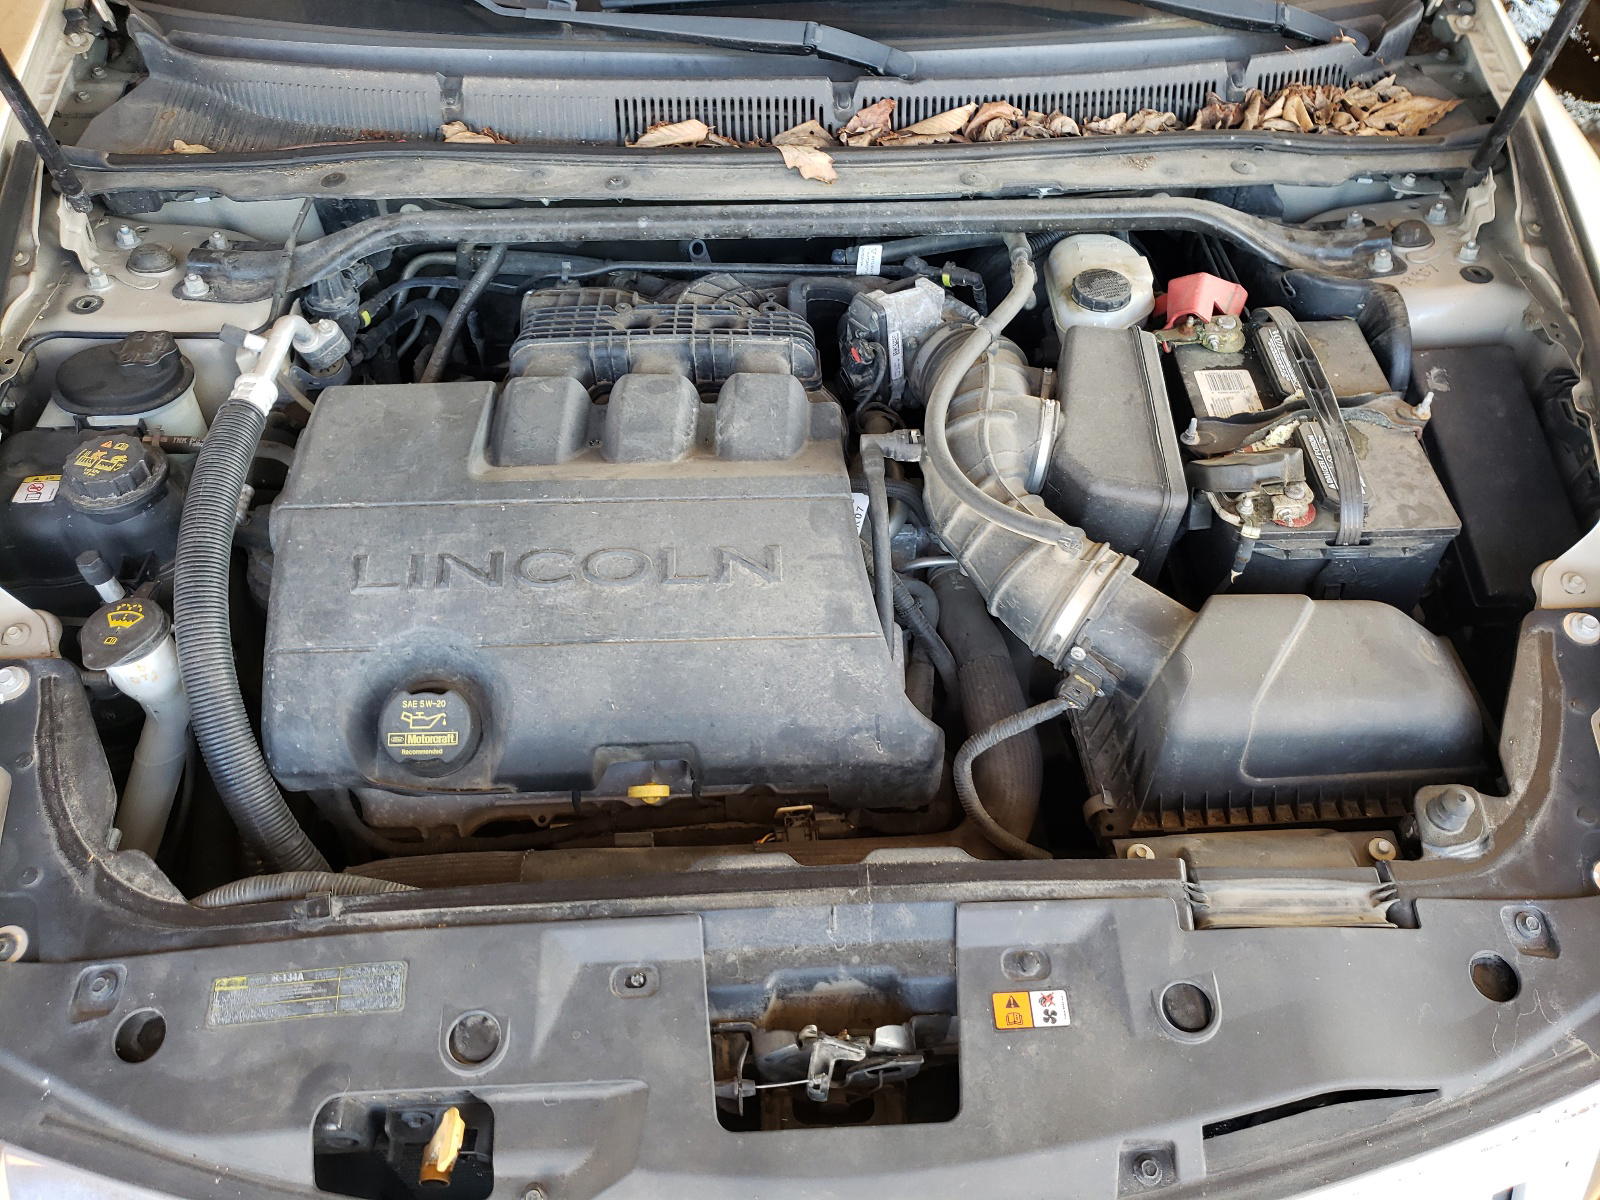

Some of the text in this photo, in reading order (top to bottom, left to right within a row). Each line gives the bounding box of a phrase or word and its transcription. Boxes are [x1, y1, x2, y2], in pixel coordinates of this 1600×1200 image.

[350, 545, 782, 593] LINCOLN
[402, 700, 418, 708] SAE
[407, 733, 457, 745] Motorcraft
[401, 748, 444, 756] Recommended
